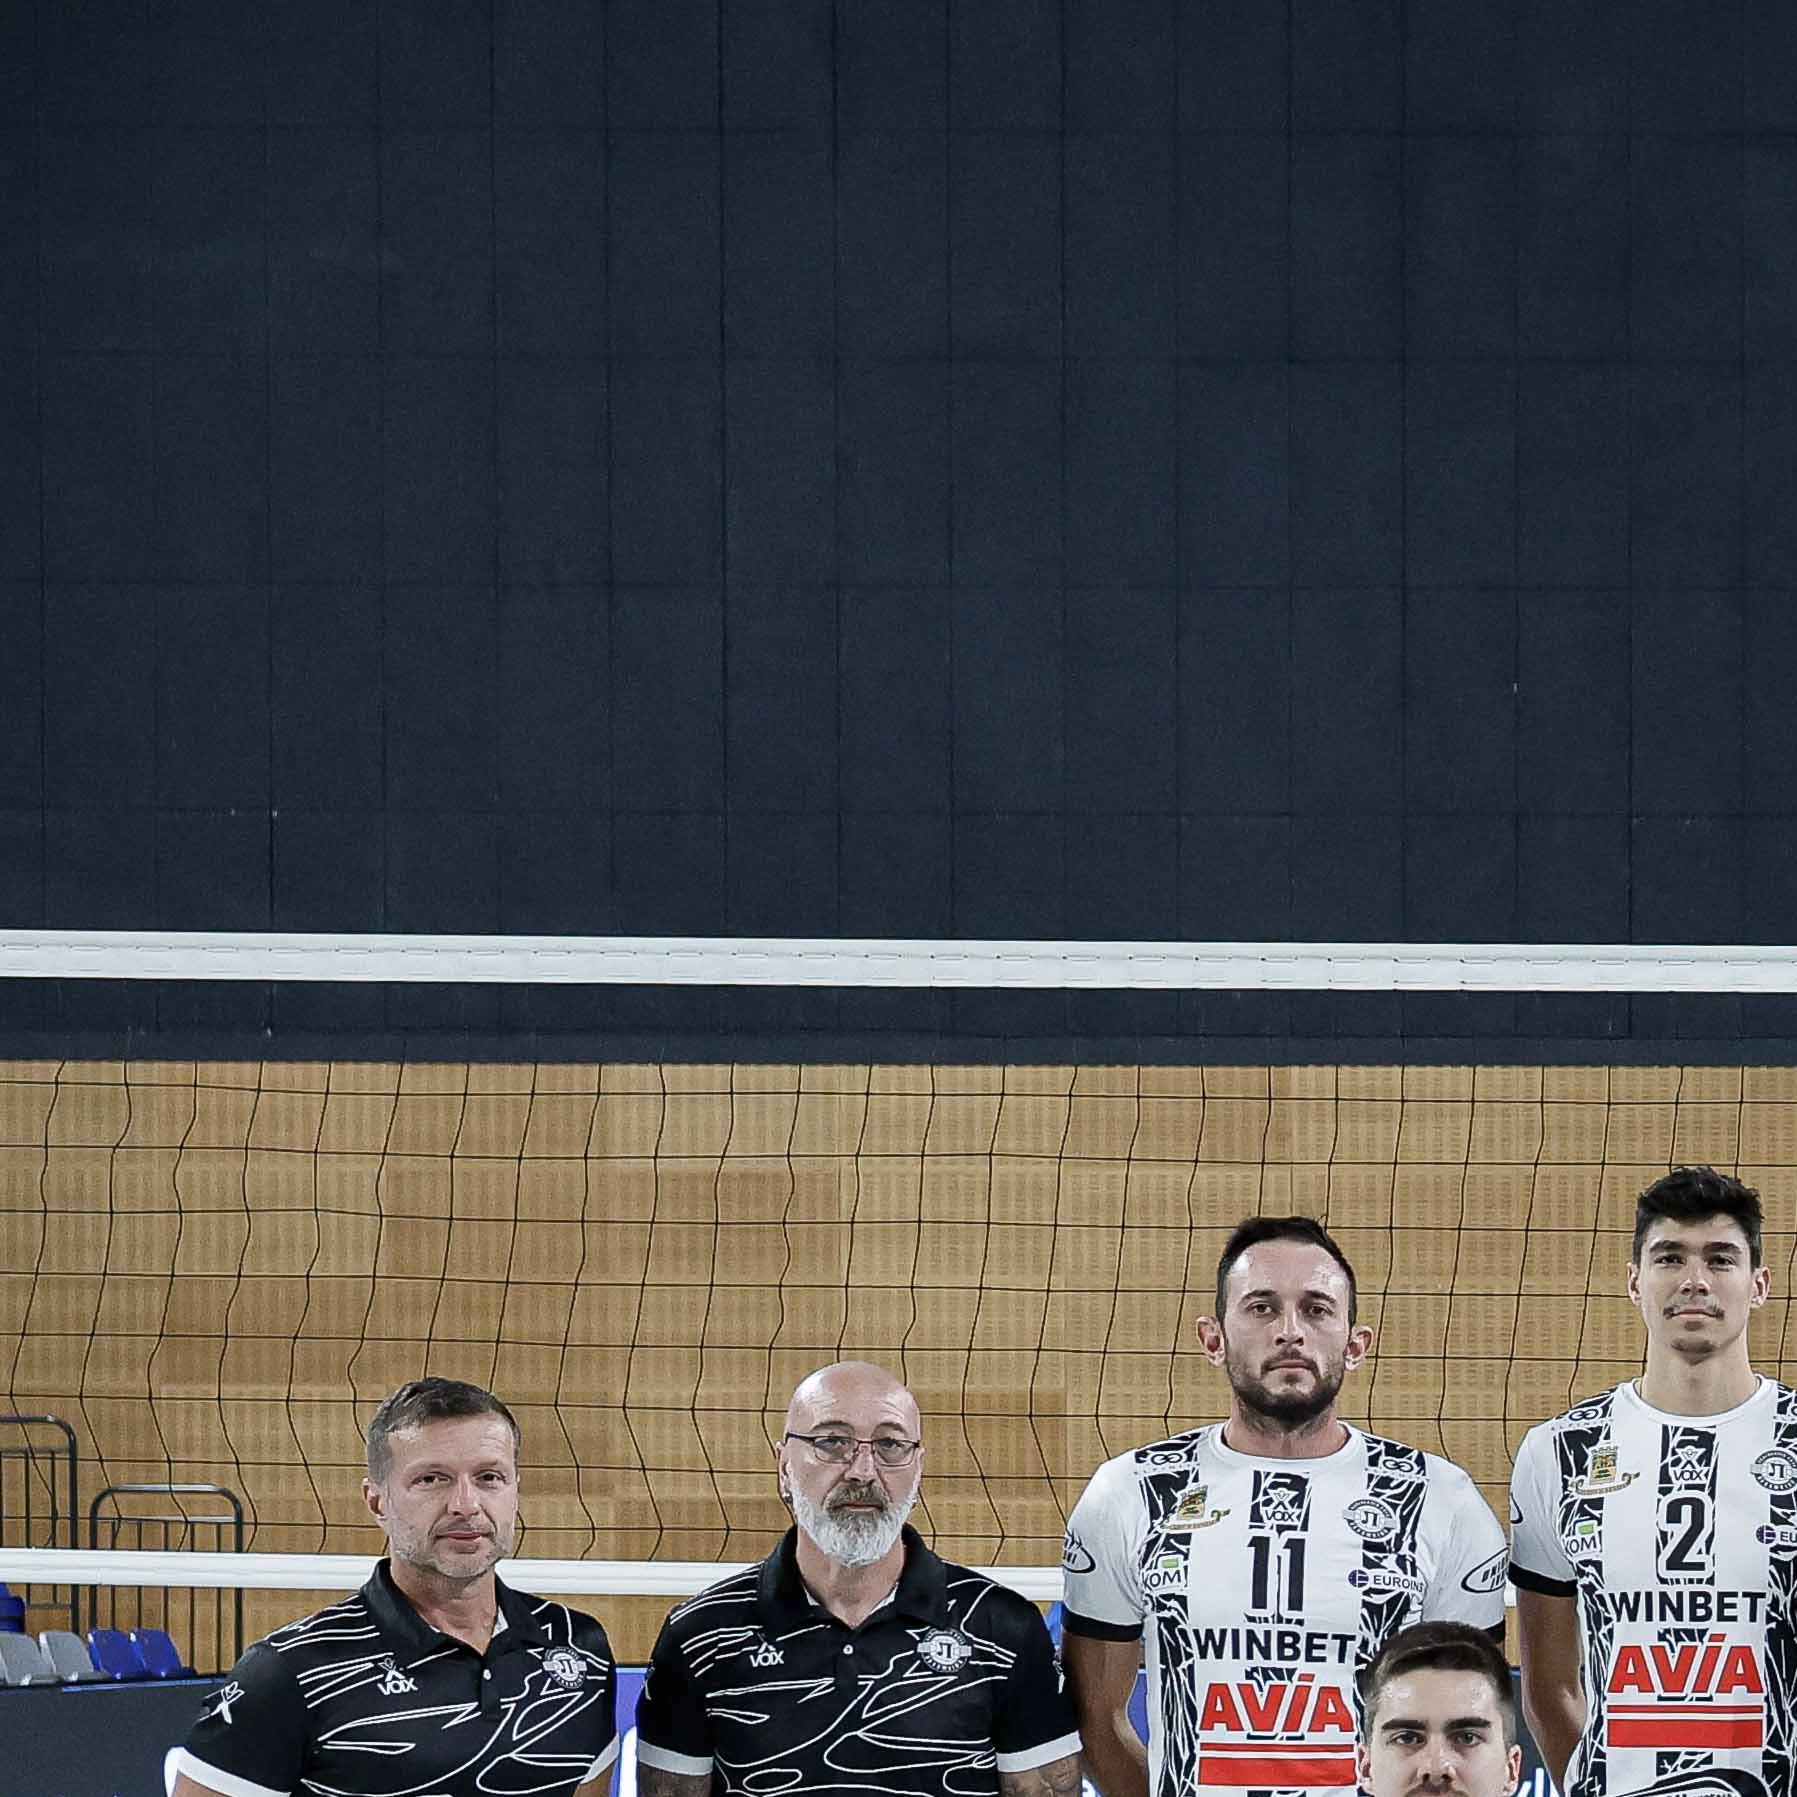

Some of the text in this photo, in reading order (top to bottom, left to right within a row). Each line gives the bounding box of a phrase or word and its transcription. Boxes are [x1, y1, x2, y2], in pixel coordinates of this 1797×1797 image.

[1665, 1497, 1706, 1571] 2
[1246, 1536, 1304, 1611] 11
[1611, 1591, 1766, 1623] WINBET
[1196, 1633, 1354, 1664] WINBET
